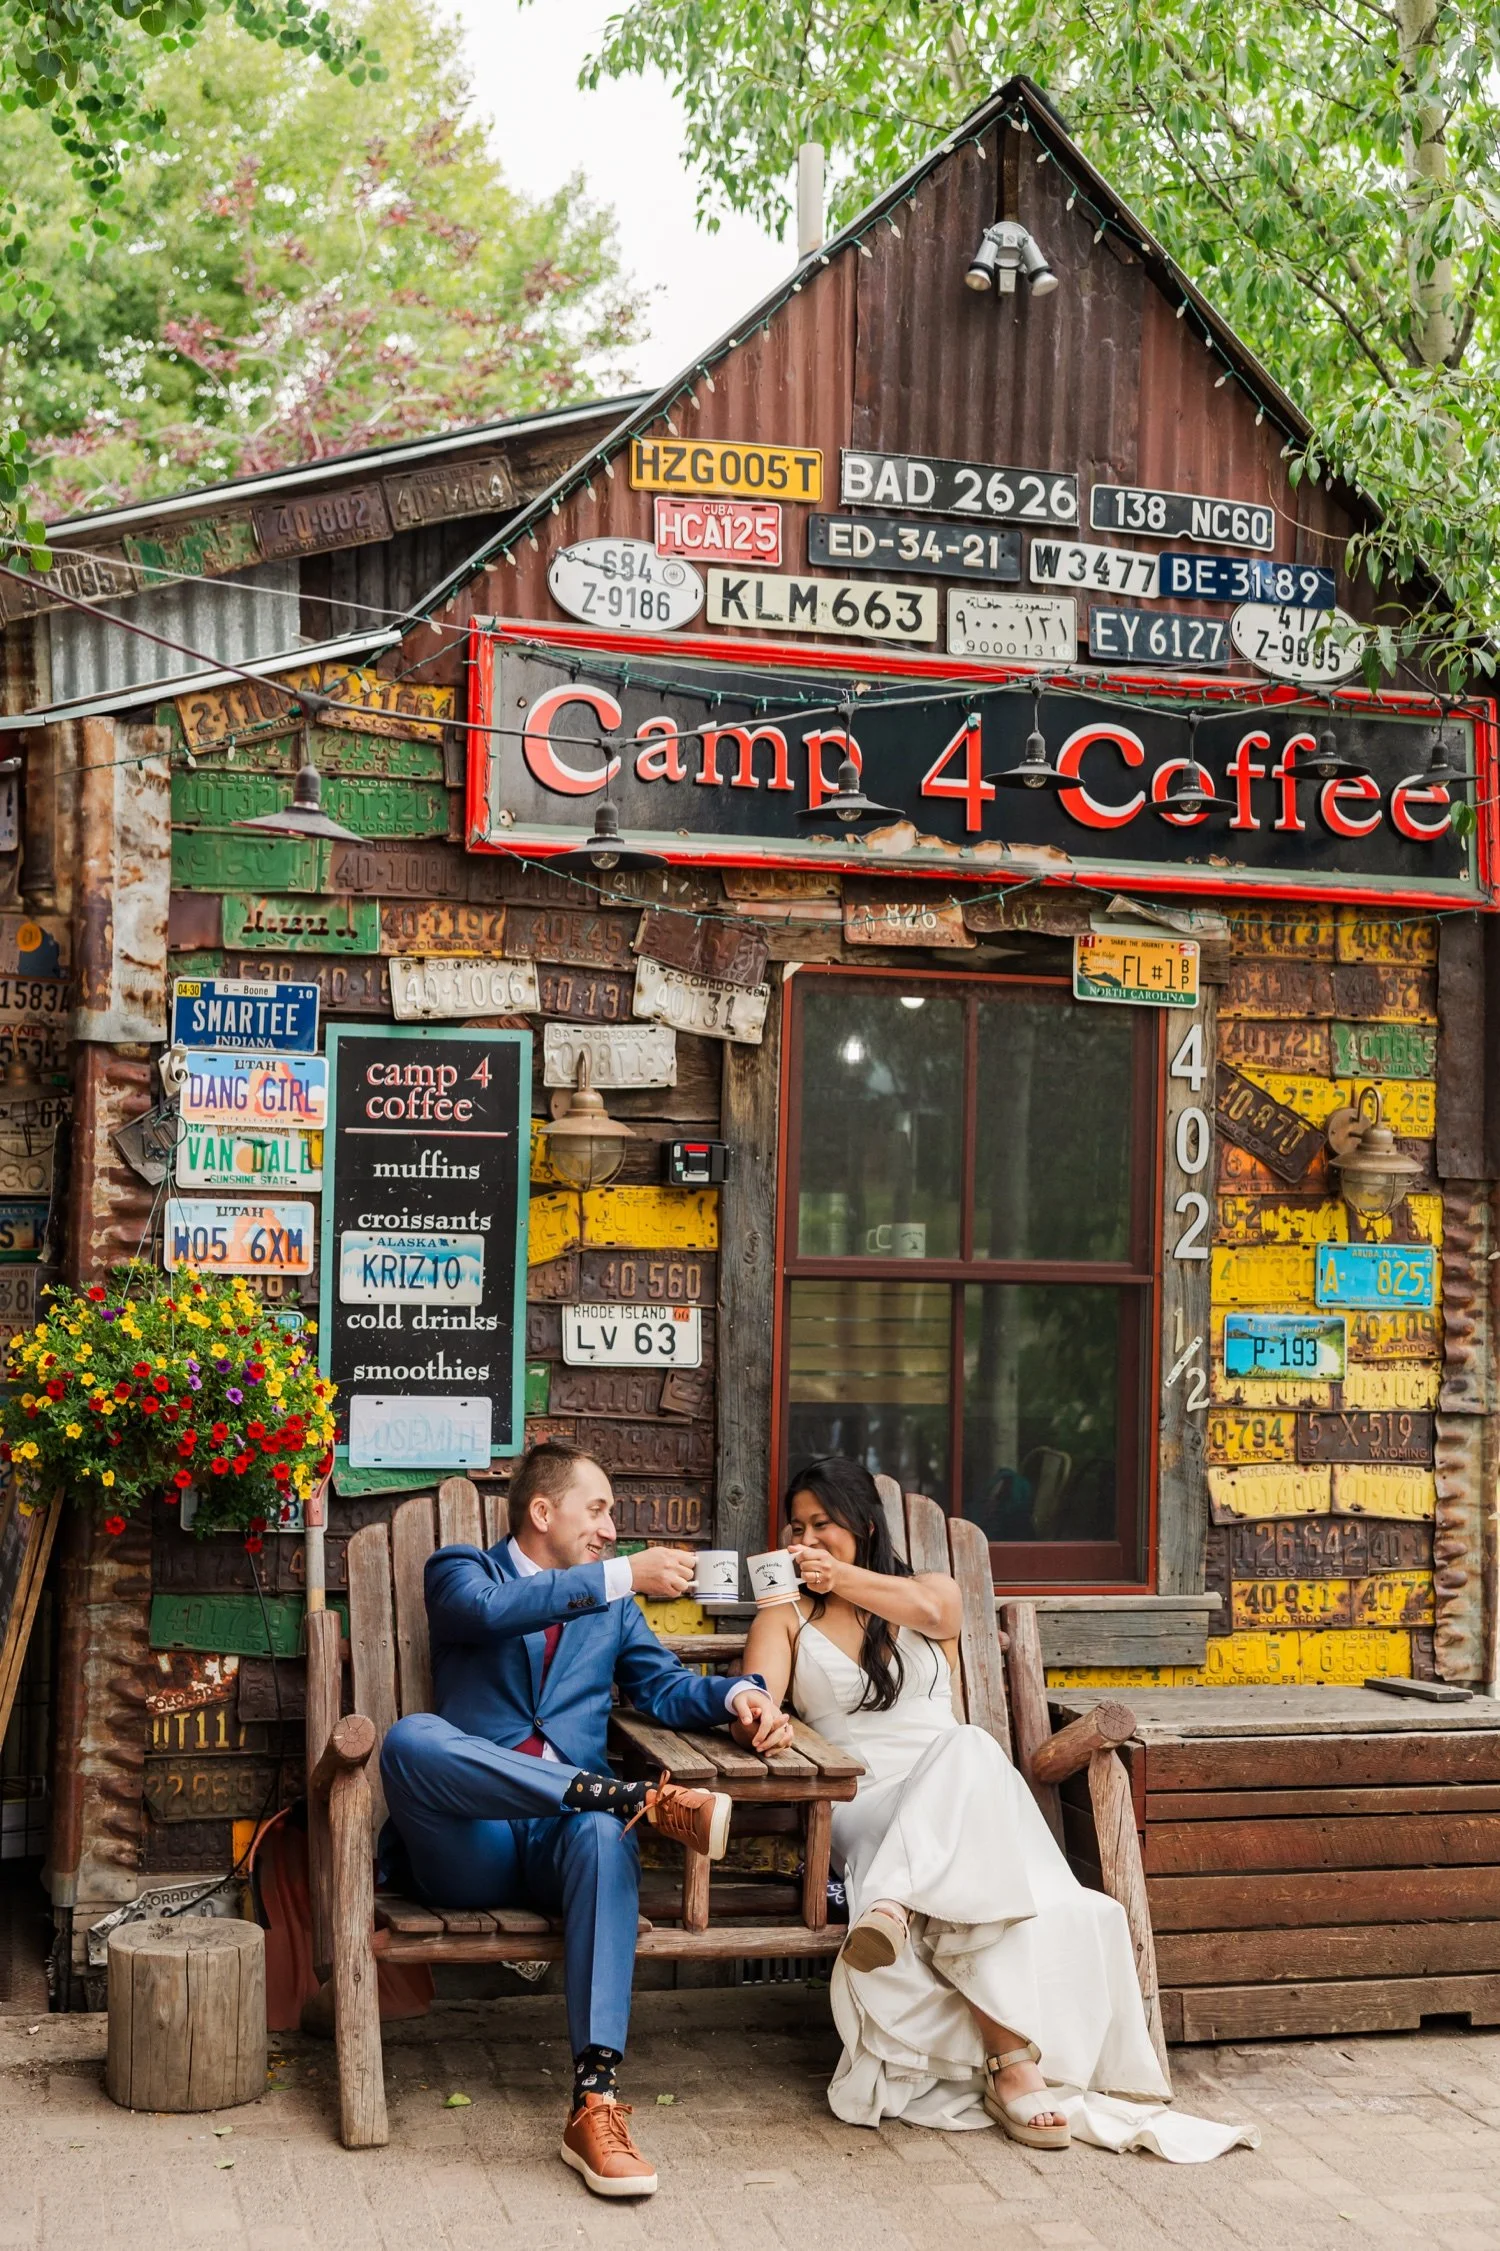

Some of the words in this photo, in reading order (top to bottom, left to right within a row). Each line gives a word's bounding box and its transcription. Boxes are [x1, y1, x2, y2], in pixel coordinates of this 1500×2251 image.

[844, 457, 935, 503] BAD
[954, 470, 1076, 519] 2626
[702, 503, 734, 517] CUBA
[1115, 490, 1166, 531] 138
[1192, 501, 1269, 545] NC60
[659, 512, 777, 553] HCA125
[828, 522, 998, 569] ED-34-21
[1172, 557, 1320, 604] BE-31-89
[582, 581, 671, 622] Z-9186
[721, 576, 819, 625] KLM
[832, 586, 923, 634] 663
[1096, 611, 1140, 654] EY
[1149, 617, 1224, 661] 6127
[523, 683, 863, 810] Camp
[920, 712, 996, 832] 4
[1056, 722, 1452, 843] Coffee
[530, 911, 568, 949] 40
[588, 919, 625, 952] 45
[1110, 938, 1127, 946] SHARE
[1129, 939, 1139, 947] THE
[177, 983, 200, 996] 04-30
[223, 984, 229, 993] 6
[243, 984, 269, 996] Boone
[298, 989, 313, 999] 10
[1089, 985, 1127, 998] NORTH
[1130, 988, 1185, 1003] CAROLINA
[192, 999, 300, 1036] SMARTEE
[215, 1034, 275, 1049] INDIANA
[234, 1059, 276, 1072] UTAH
[366, 1062, 458, 1097] camp
[466, 1054, 493, 1089] 4
[190, 1074, 248, 1110] DANG
[262, 1077, 318, 1113] GIRL
[365, 1087, 473, 1122] coffee
[188, 1136, 235, 1172] VAN
[252, 1139, 313, 1175] DALE
[372, 1149, 481, 1181] muffins
[210, 1174, 257, 1185] SUNSHINE
[260, 1175, 291, 1186] STATE
[216, 1206, 264, 1218] UTAH
[357, 1206, 492, 1231] croissants
[250, 1227, 303, 1263] 6XM
[376, 1236, 437, 1248] ALASKA
[362, 1253, 461, 1290] KRIZ10
[600, 1260, 702, 1300] 40-560
[1376, 1259, 1425, 1297] 825
[346, 1303, 403, 1330] cold
[412, 1304, 498, 1331] drinks
[573, 1306, 616, 1319] RHODE
[620, 1306, 667, 1321] ISLAND
[577, 1324, 618, 1350] LV
[634, 1322, 676, 1355] 63
[1252, 1334, 1318, 1367] P-193
[353, 1351, 491, 1383] smoothies
[356, 1418, 486, 1453] YOSEMITE
[1369, 1447, 1428, 1459] WYOMING
[1258, 1614, 1323, 1625] COLORADO
[184, 1634, 260, 1650] COLORADO
[1204, 1675, 1271, 1686] COLORADO
